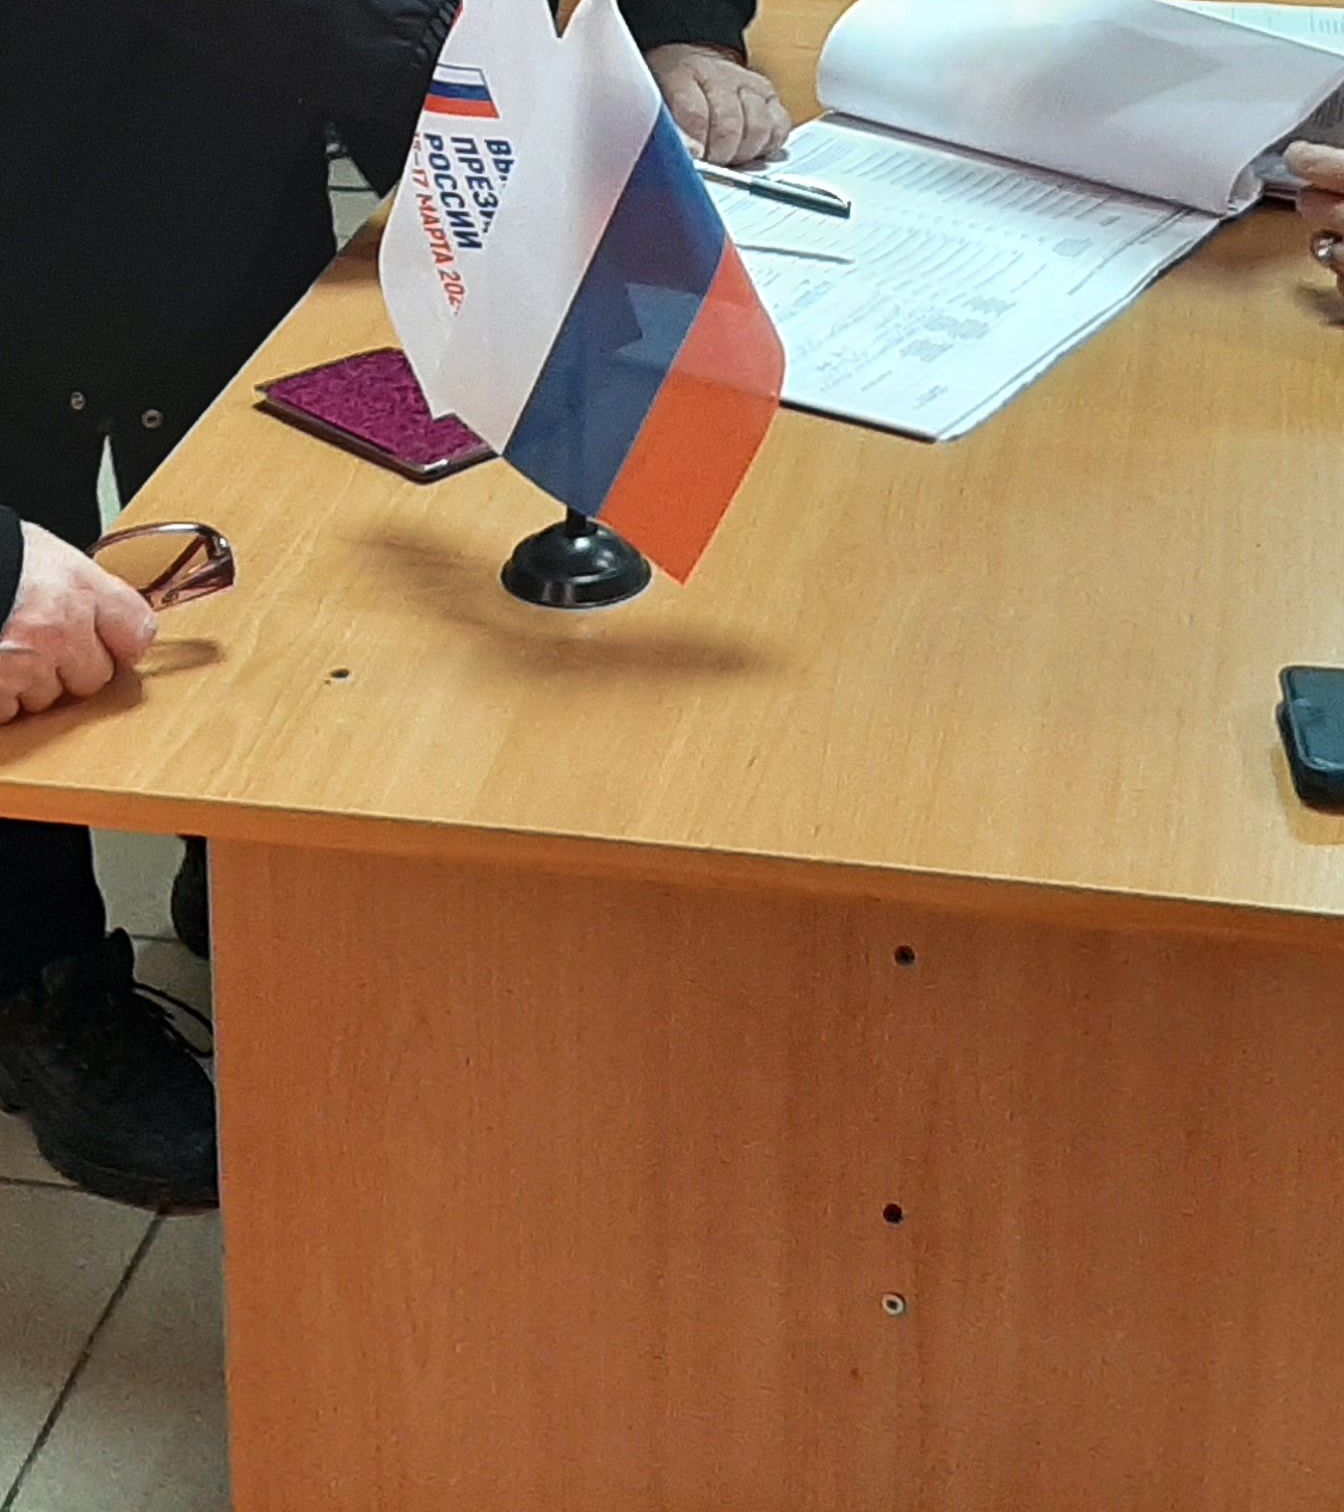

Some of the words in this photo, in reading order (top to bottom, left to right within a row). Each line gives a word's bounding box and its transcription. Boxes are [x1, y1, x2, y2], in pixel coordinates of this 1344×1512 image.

[423, 132, 483, 249] РОССИИ
[415, 192, 455, 266] МАРТА
[437, 268, 467, 316] 202
